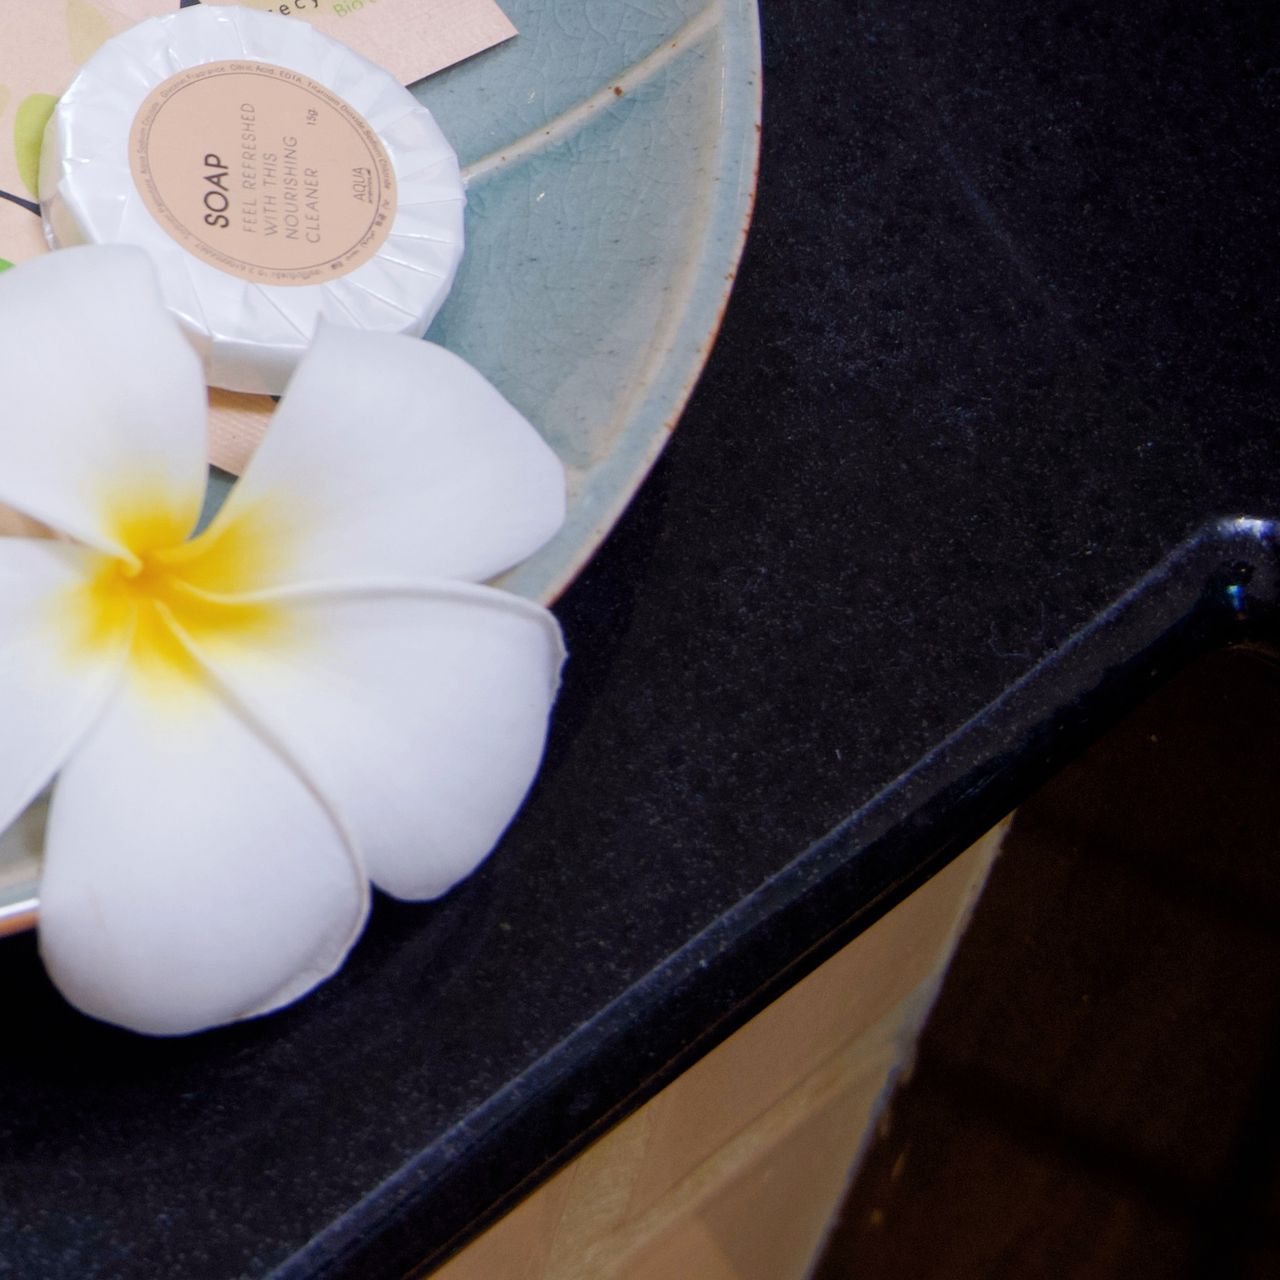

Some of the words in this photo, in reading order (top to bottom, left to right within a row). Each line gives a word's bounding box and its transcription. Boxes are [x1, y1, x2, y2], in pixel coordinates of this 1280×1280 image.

[240, 102, 257, 190] REFRESHED
[263, 151, 278, 189] THIS
[203, 153, 231, 229] SOAP
[282, 135, 299, 240] NOURISHING
[304, 167, 322, 244] CLEANER
[351, 166, 368, 202] AQUA
[241, 202, 258, 235] FEEL
[263, 194, 280, 237] WITH
